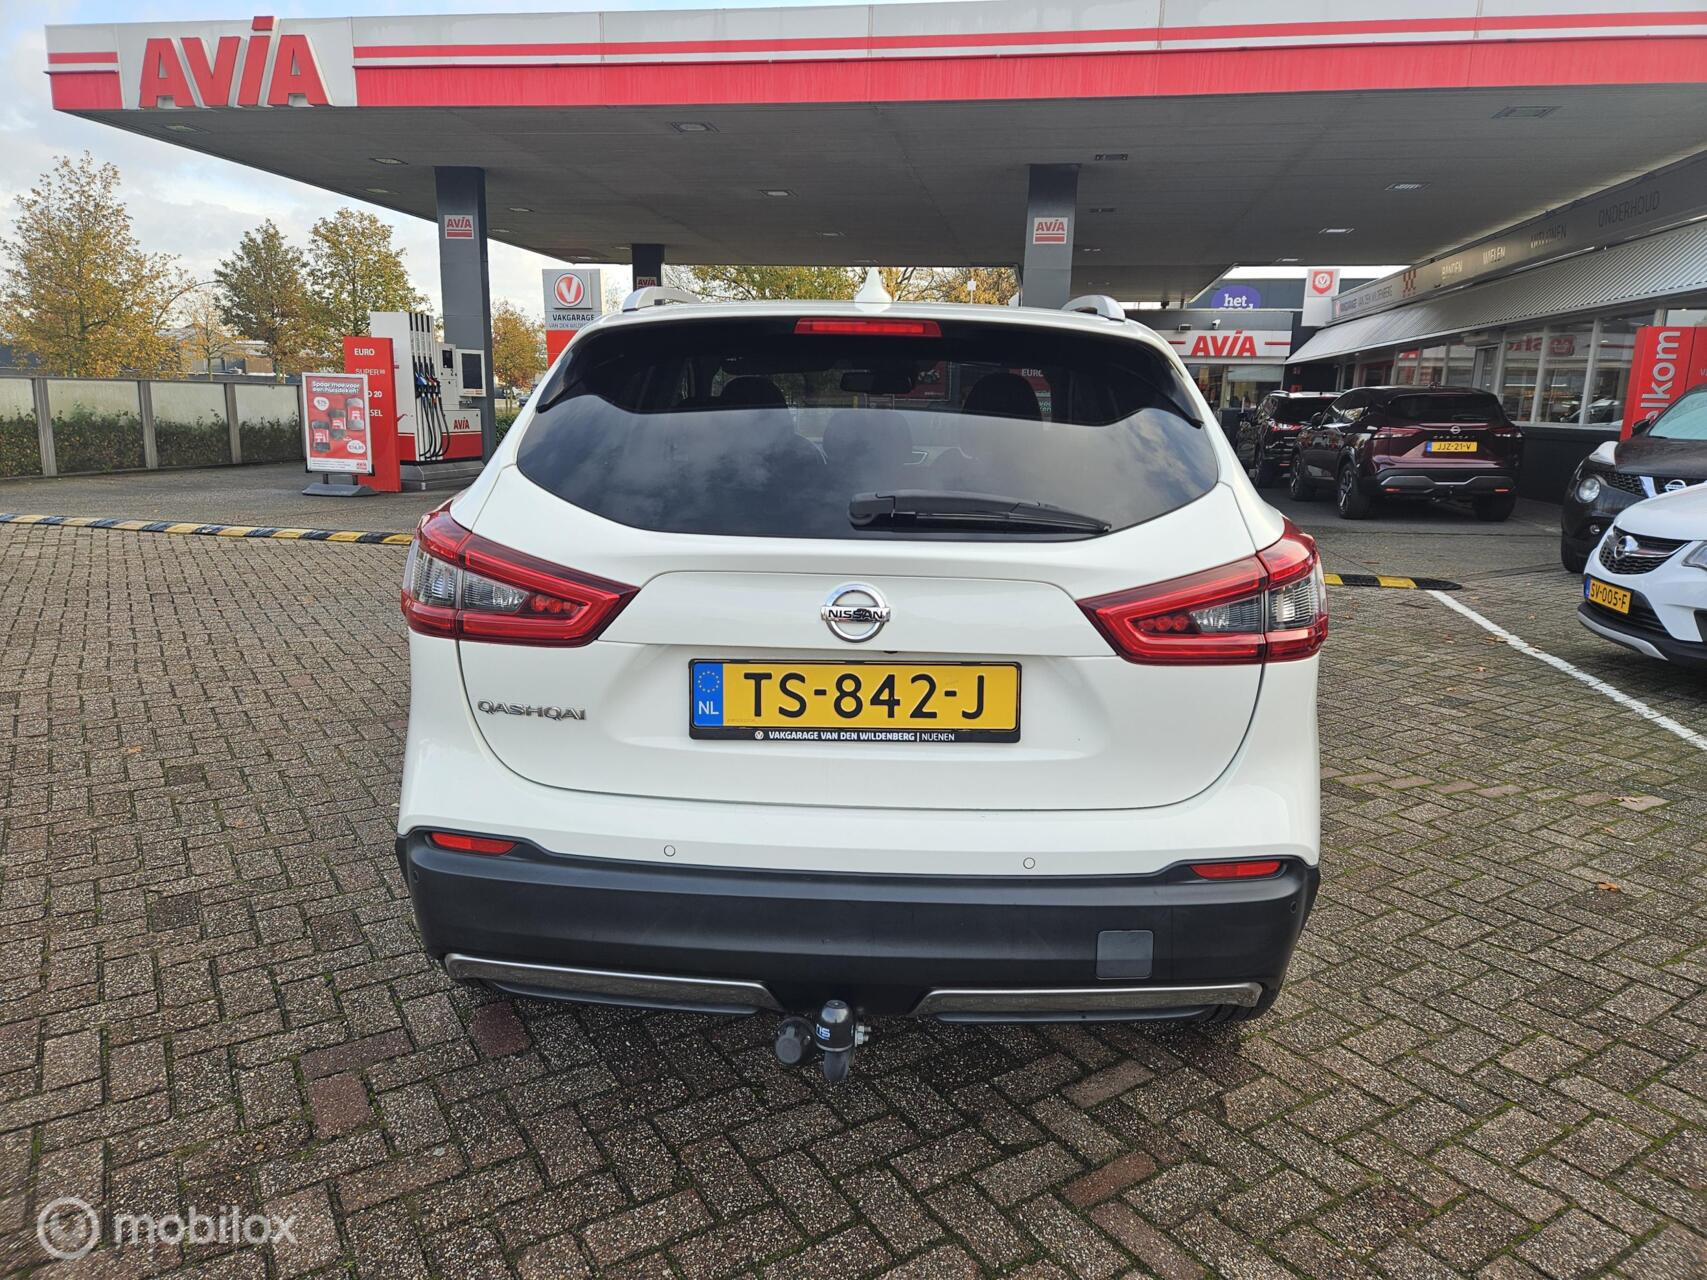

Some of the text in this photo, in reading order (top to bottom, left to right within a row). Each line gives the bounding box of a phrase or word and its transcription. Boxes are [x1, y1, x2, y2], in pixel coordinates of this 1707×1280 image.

[139, 16, 328, 108] AVIA
[1598, 190, 1661, 227] ONDERHOUD
[447, 217, 472, 228] AVIA
[1036, 219, 1065, 231] AVIA
[1223, 293, 1247, 307] het
[1191, 330, 1257, 357] AVIA
[354, 347, 375, 356] EURO
[370, 409, 383, 417] SEL
[453, 417, 470, 429] AVIA
[1437, 443, 1472, 451] JJZ-21-V
[1590, 583, 1628, 608] SV-005-F
[828, 609, 883, 620] NISSAN
[698, 672, 985, 719] NL TS-842-J
[478, 699, 587, 721] QASHQAI
[769, 731, 955, 741] VAKGARAGE VAN DEN WILDENBERG NUENEN
